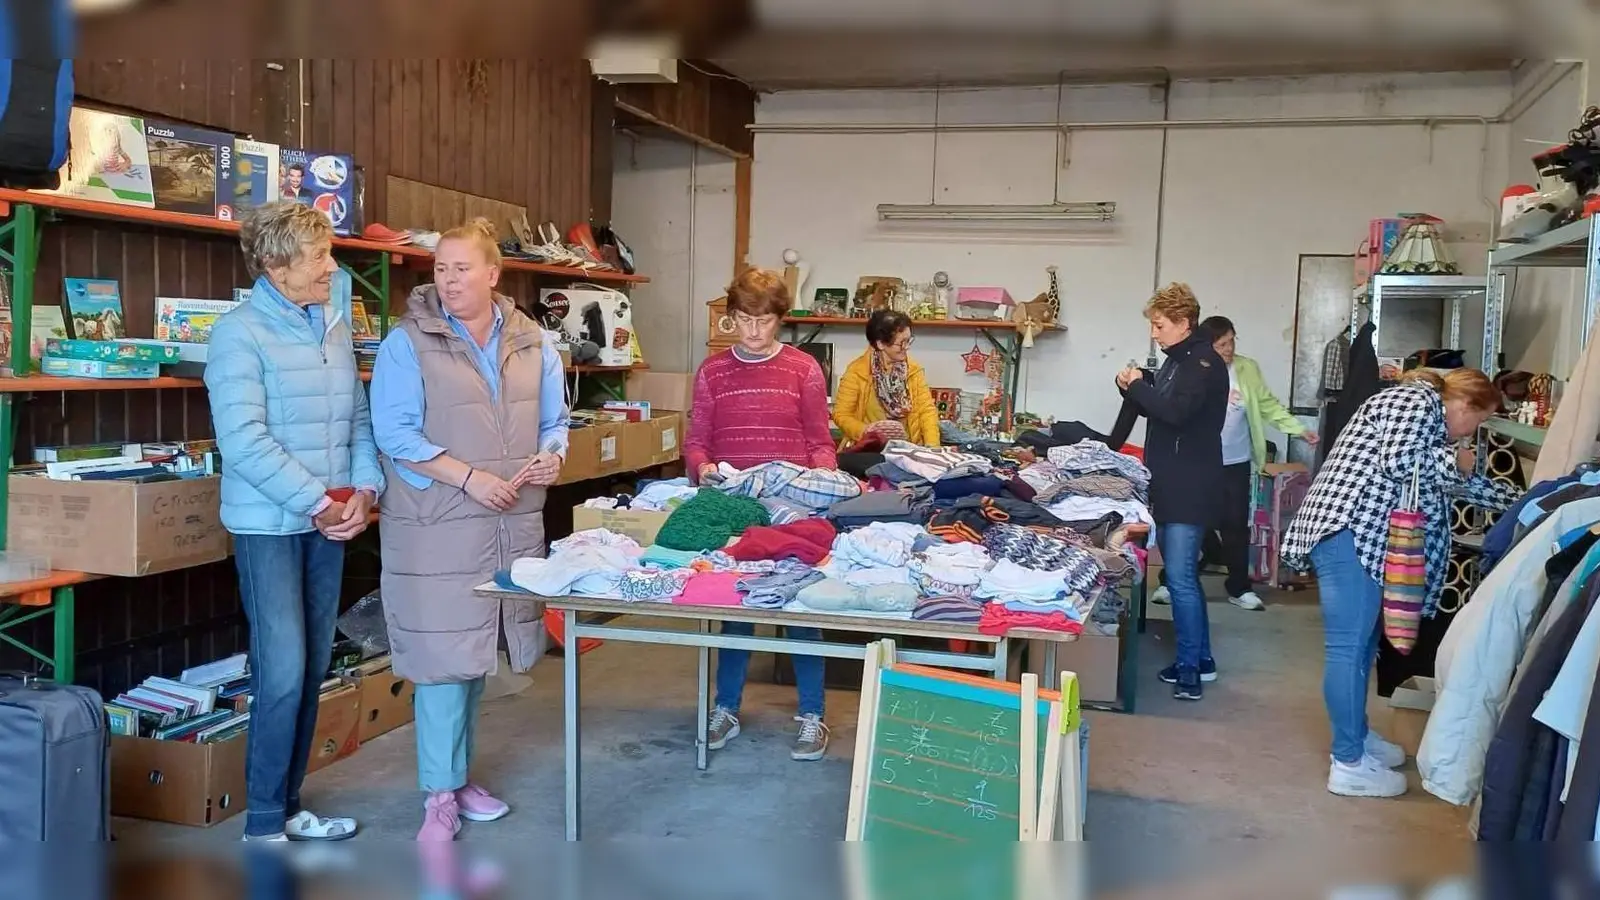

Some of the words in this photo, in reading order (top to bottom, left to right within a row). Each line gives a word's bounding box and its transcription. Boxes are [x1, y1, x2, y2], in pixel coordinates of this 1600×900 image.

[147, 126, 175, 138] Puzzle
[241, 142, 265, 153] Puzzle
[221, 146, 231, 169] 1000
[964, 803, 997, 821] 125
